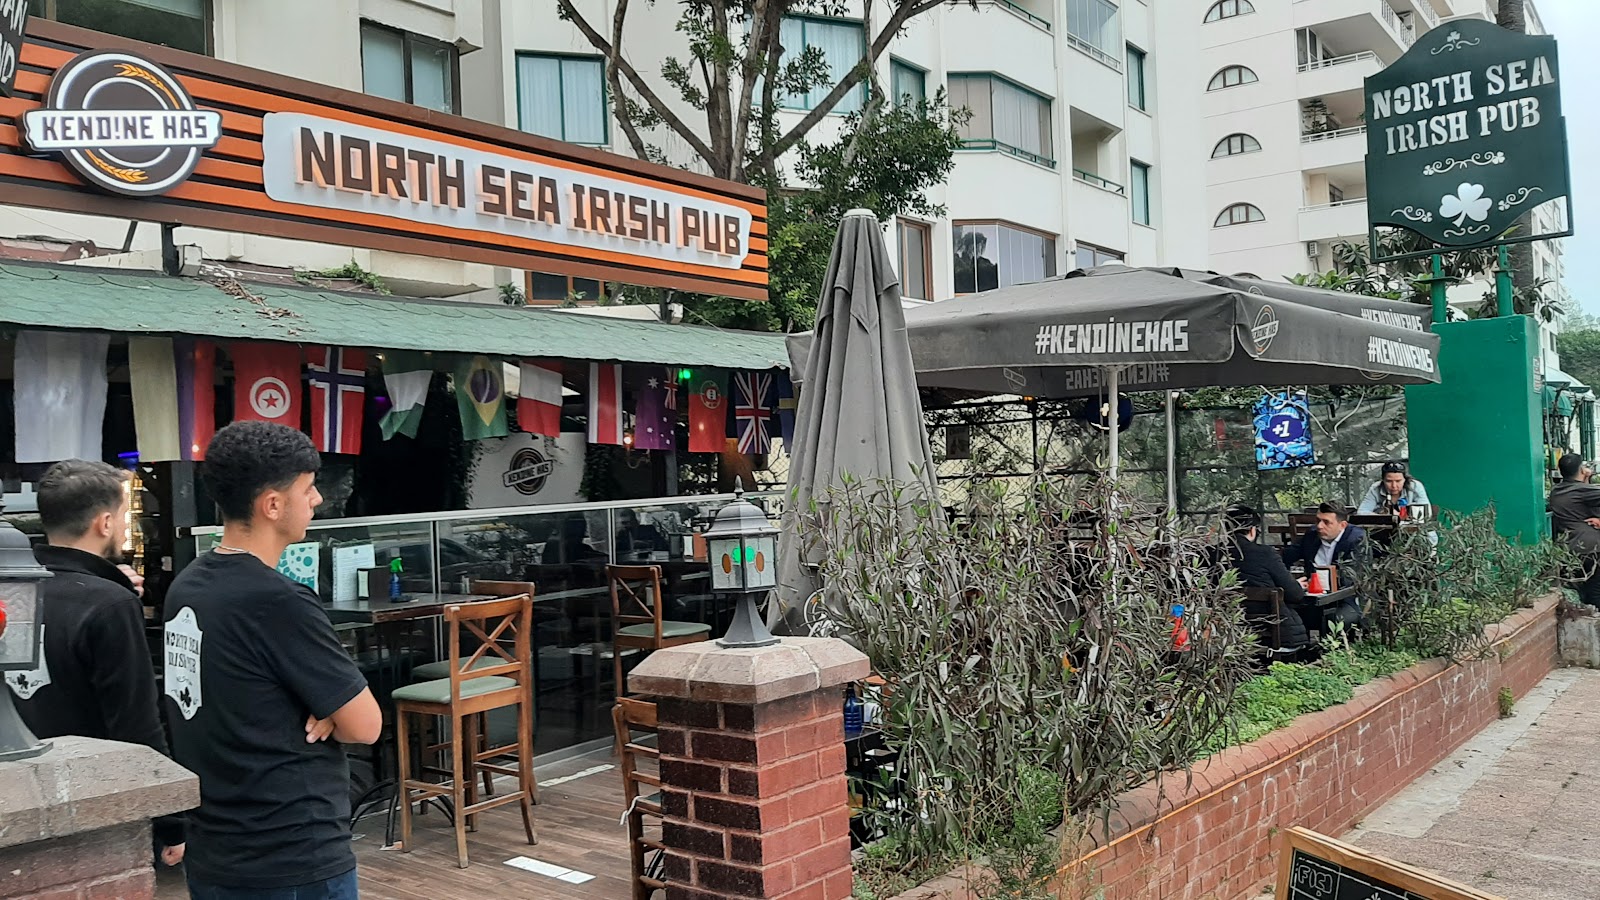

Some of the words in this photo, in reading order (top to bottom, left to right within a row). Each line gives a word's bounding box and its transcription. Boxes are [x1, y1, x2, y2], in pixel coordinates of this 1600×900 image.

[1372, 71, 1474, 120] NORTH
[1486, 56, 1555, 96] SEA
[162, 116, 208, 139] HAS
[1385, 111, 1469, 155] IRISH
[1478, 97, 1540, 136] PUB
[299, 126, 466, 209] NORTH
[481, 164, 561, 225] SEA
[572, 183, 671, 244] IRISH
[681, 206, 741, 256] PUB
[1272, 420, 1290, 438] +1
